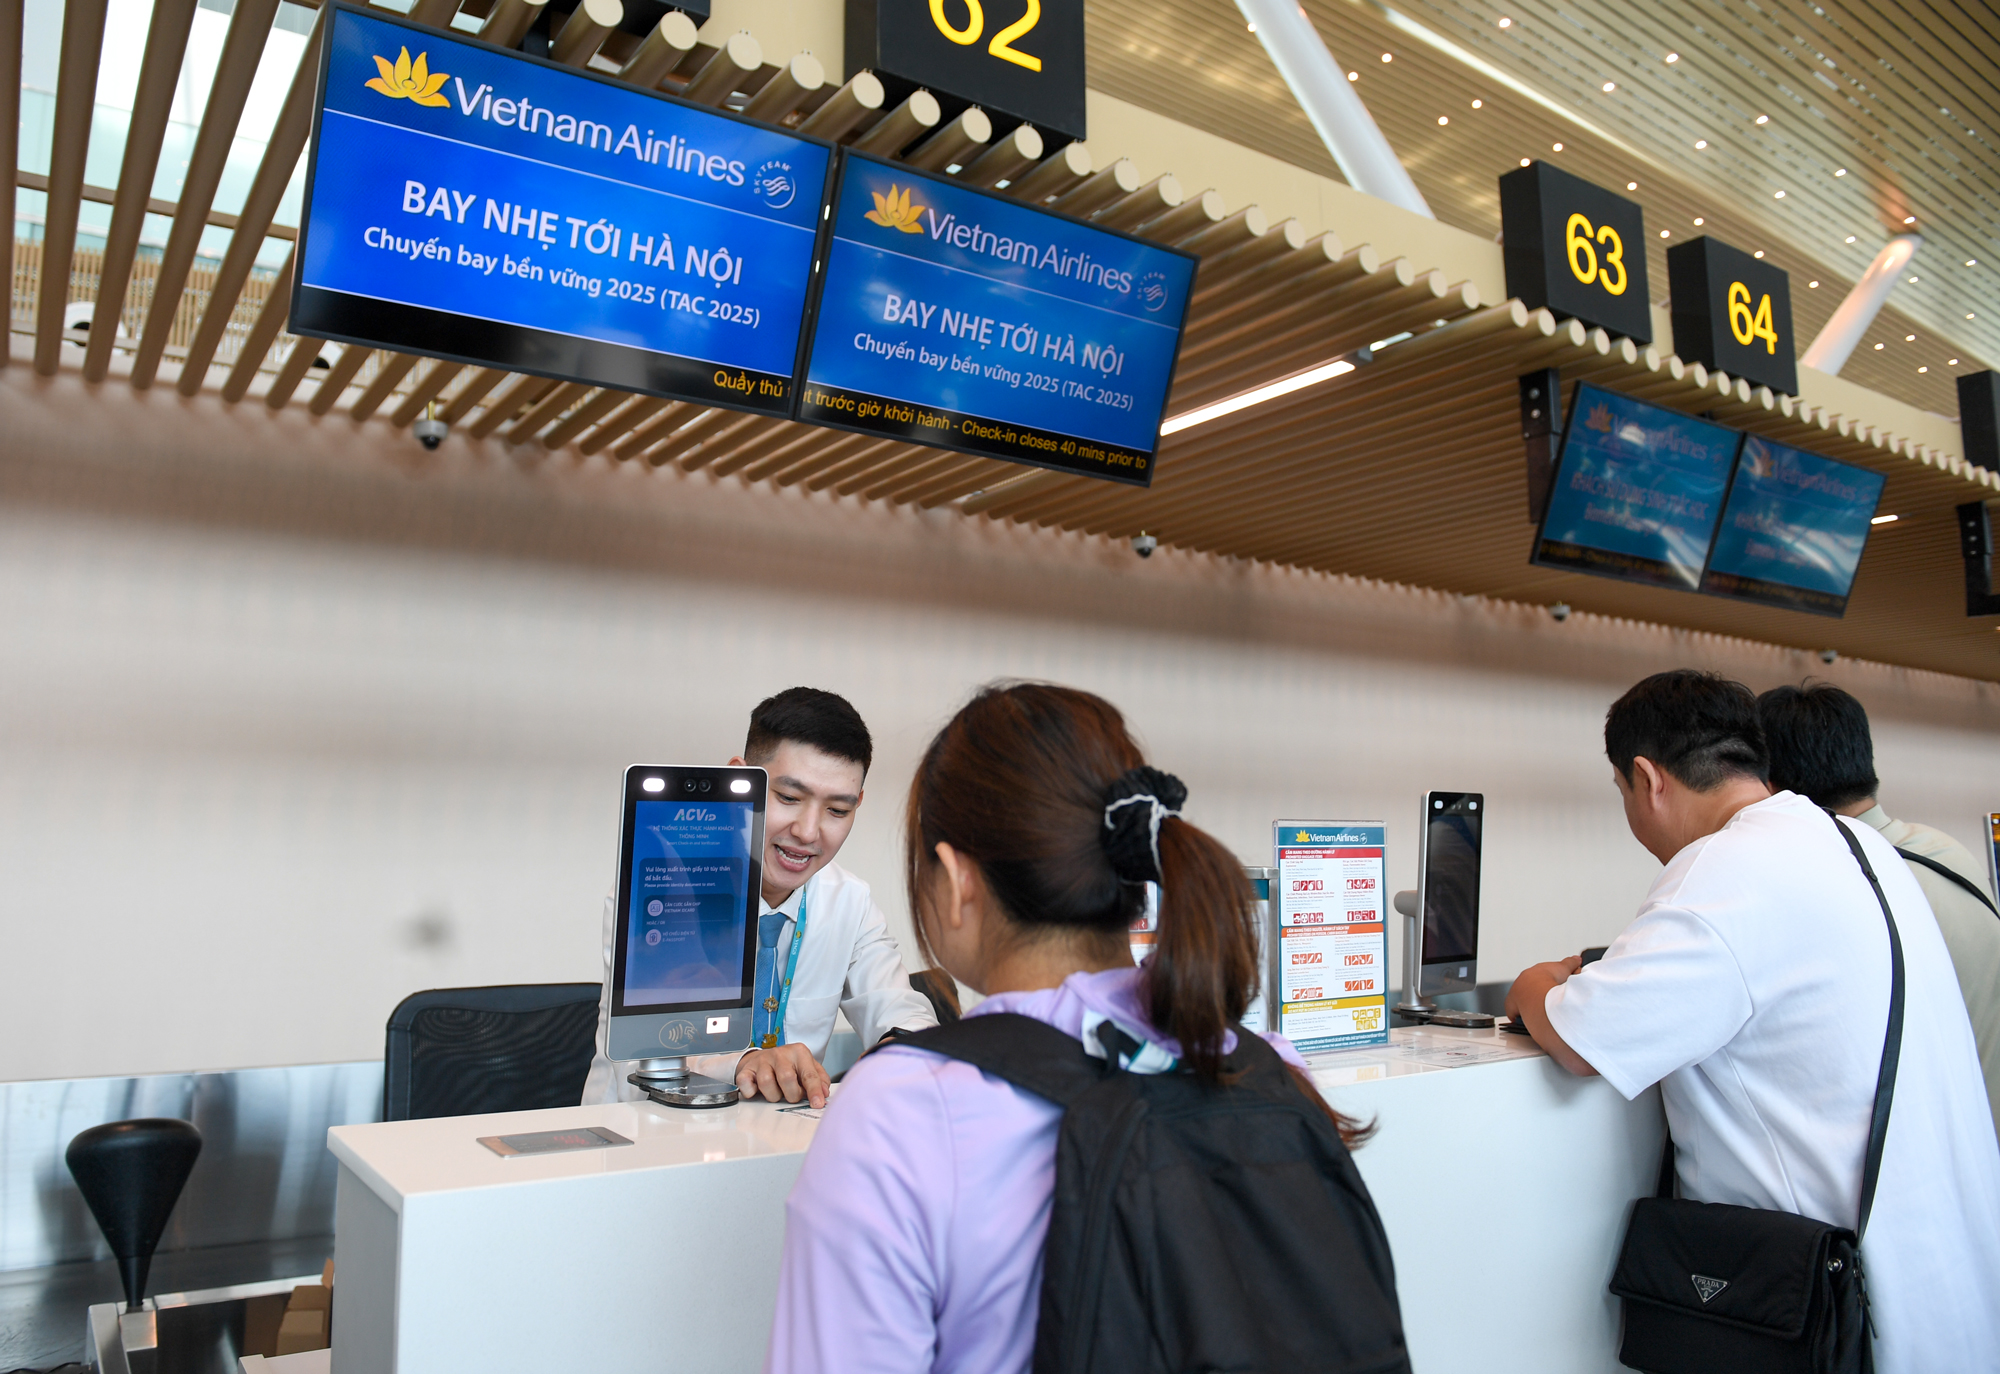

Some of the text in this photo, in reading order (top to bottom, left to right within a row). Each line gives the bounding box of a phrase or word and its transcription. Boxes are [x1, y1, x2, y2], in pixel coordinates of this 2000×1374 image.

[402, 180, 742, 289] BAY NHẸ TỚI HÀ NỘI
[1566, 212, 1627, 296] 63
[364, 226, 760, 328] Chuyến bay bền vững 2025 (TAC 2025)
[883, 294, 1124, 378] BAY NHẸ TỚI HÀ NỘI
[1728, 281, 1778, 354] 64
[713, 370, 783, 398] Quầy thủ
[854, 332, 1133, 411] Chuyến bay bền vững 2025 (TAC 2025)
[816, 390, 855, 414] trước
[858, 398, 880, 419] giờ
[884, 404, 914, 426] khởi
[917, 411, 949, 430] hành
[962, 420, 1017, 444] Check-in
[1020, 433, 1057, 452] closes
[1060, 440, 1076, 455] 40
[1078, 445, 1104, 462] mins
[1107, 451, 1132, 469] prior
[1135, 455, 1146, 470] to
[1697, 1278, 1719, 1288] PRADA
